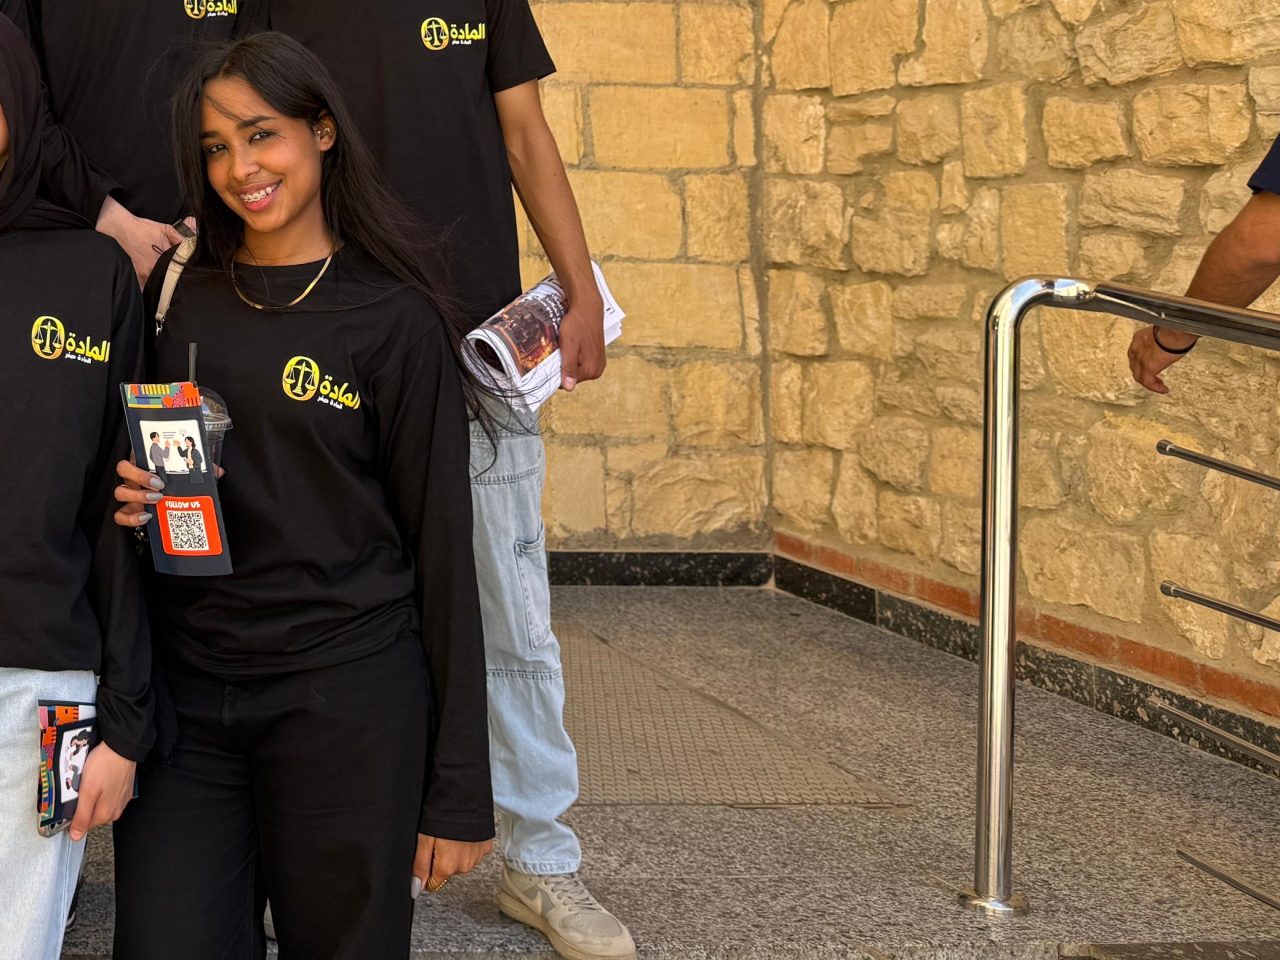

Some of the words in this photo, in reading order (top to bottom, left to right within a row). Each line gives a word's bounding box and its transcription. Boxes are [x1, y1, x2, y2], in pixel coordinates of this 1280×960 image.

[450, 22, 486, 40] المادة
[65, 332, 111, 363] المادة
[165, 501, 189, 509] FOLLOW
[191, 501, 201, 509] US
